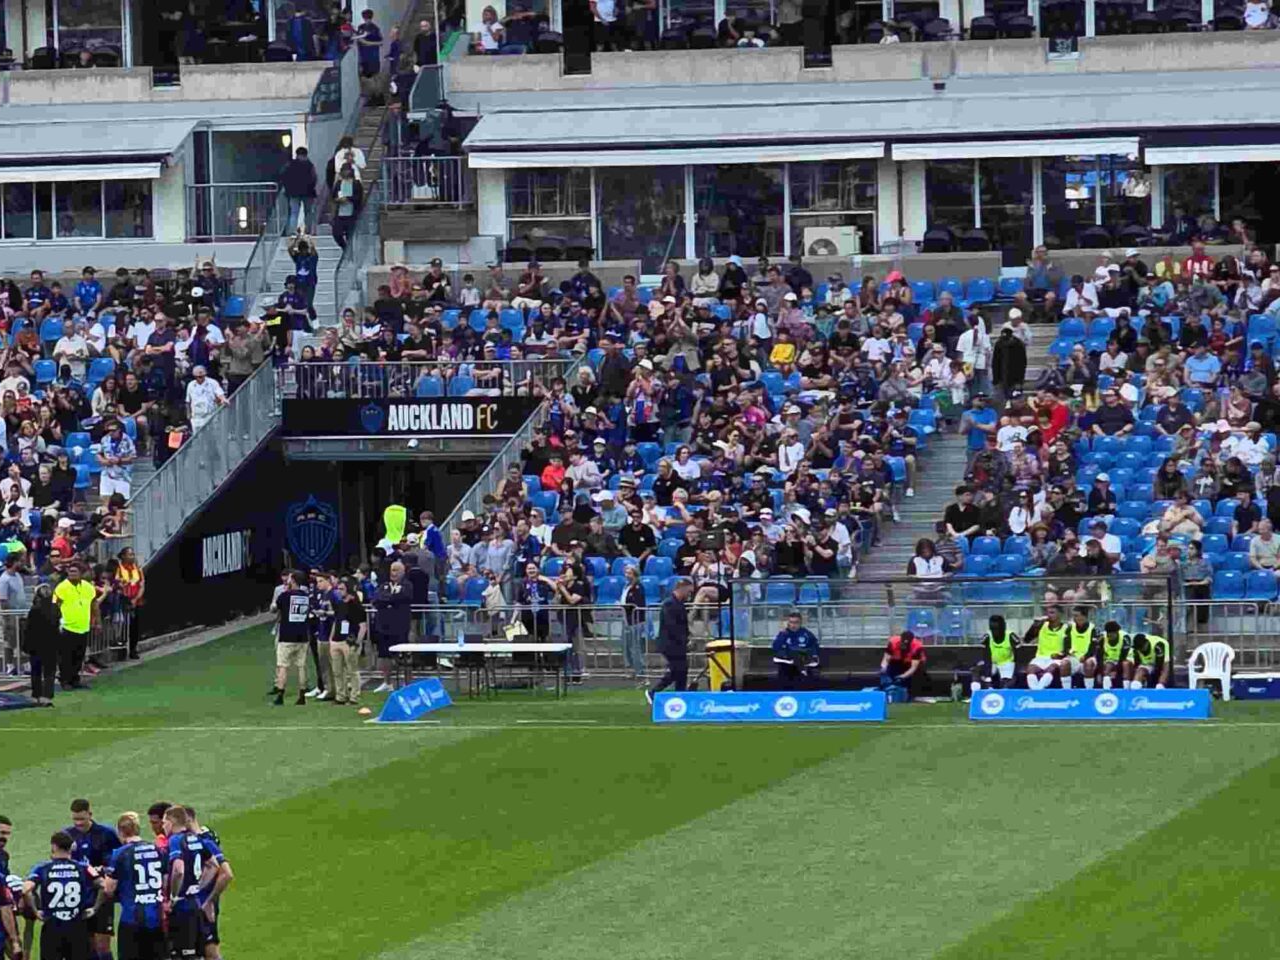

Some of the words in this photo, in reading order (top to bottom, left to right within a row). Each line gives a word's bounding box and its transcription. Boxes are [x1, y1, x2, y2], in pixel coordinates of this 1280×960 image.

[388, 404, 473, 430] AUCKLAND
[476, 404, 498, 429] FC
[202, 531, 241, 577] AUCKLAND
[133, 861, 162, 890] 15
[46, 881, 81, 908] 28
